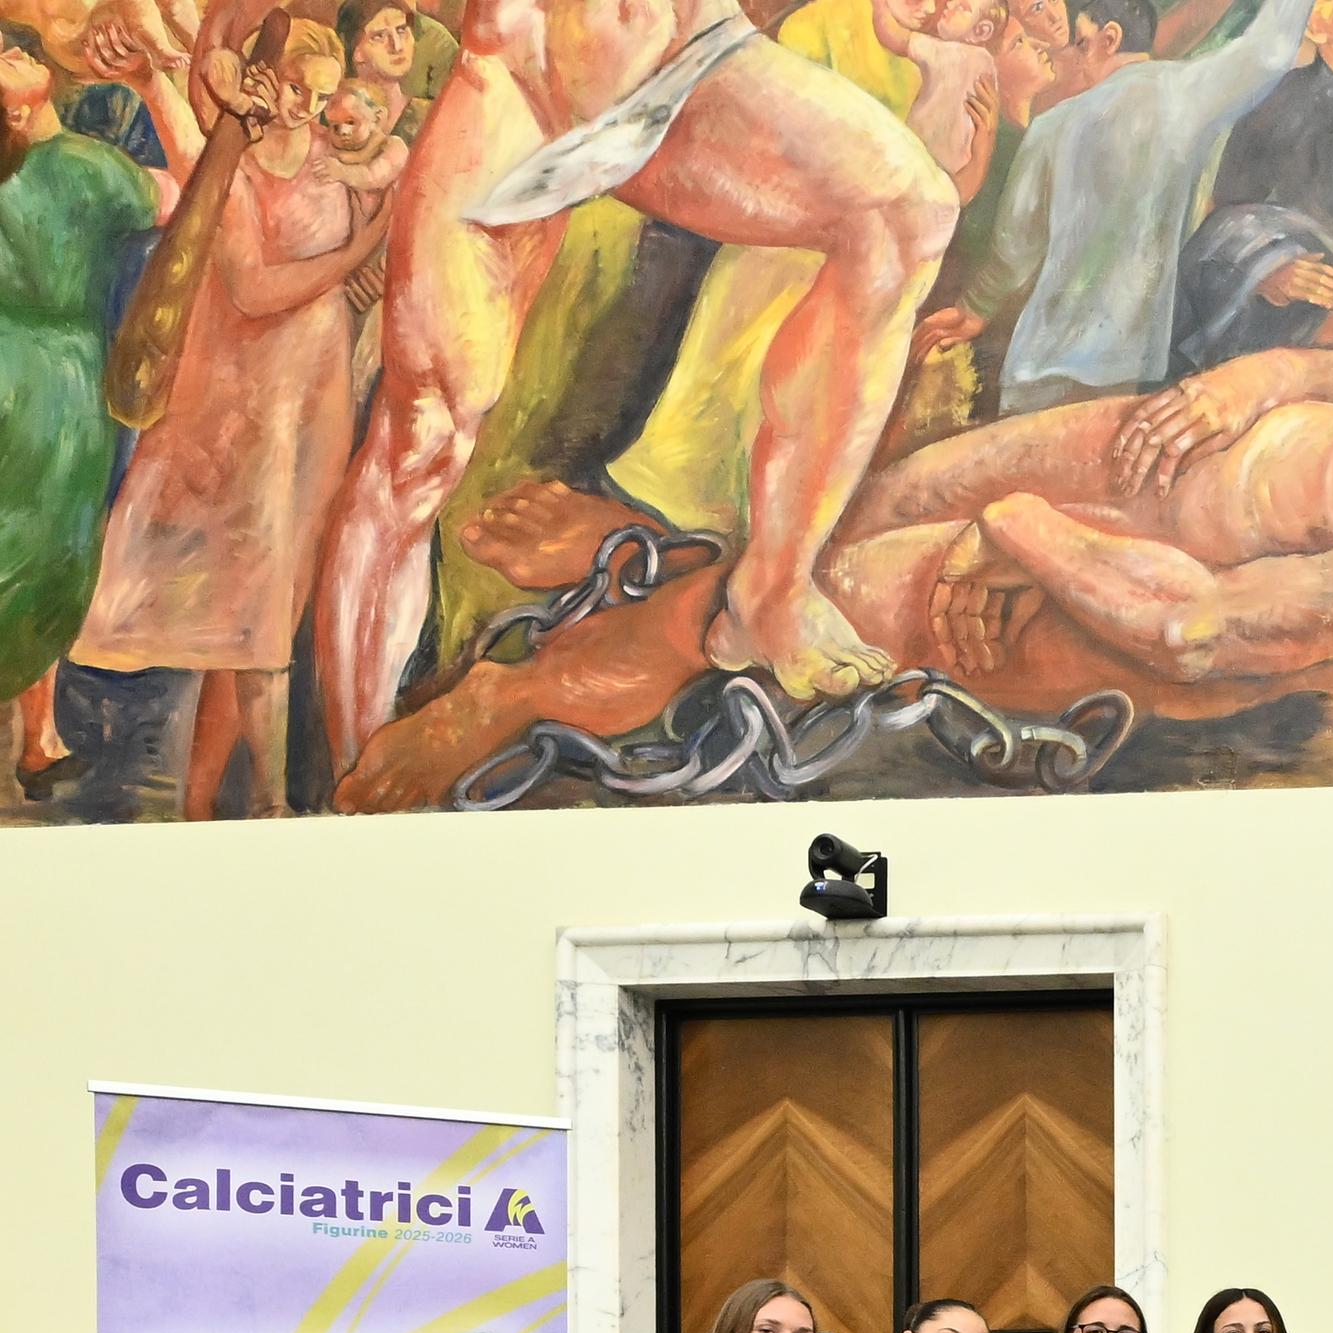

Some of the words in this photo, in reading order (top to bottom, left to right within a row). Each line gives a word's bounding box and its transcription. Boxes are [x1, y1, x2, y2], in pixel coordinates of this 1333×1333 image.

[120, 1163, 472, 1227] Calciatrici
[312, 1221, 388, 1239] Figurine
[394, 1229, 472, 1244] 2025-2026
[494, 1234, 527, 1242] SERIE
[492, 1241, 537, 1250] WOMEN
